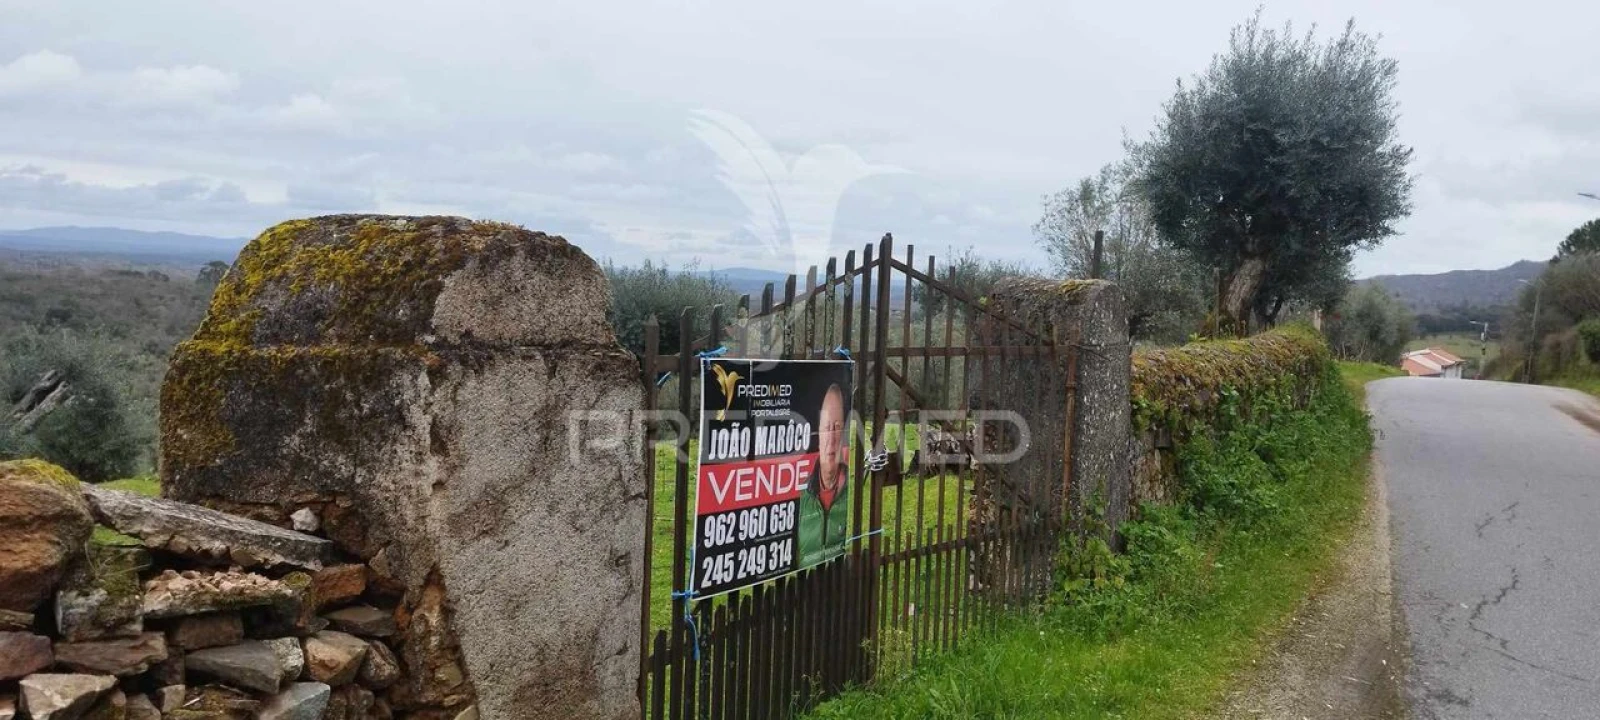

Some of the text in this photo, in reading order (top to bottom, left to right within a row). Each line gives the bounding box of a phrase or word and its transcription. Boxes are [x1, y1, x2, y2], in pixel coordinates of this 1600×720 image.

[737, 384, 792, 397] PREDIMED
[751, 408, 791, 417] PORTALEGRE
[708, 418, 811, 461] JOÃO MARÔCO
[708, 460, 810, 505] VENDE
[704, 501, 795, 548] 962 960 658
[701, 538, 792, 588] 245 249 314
